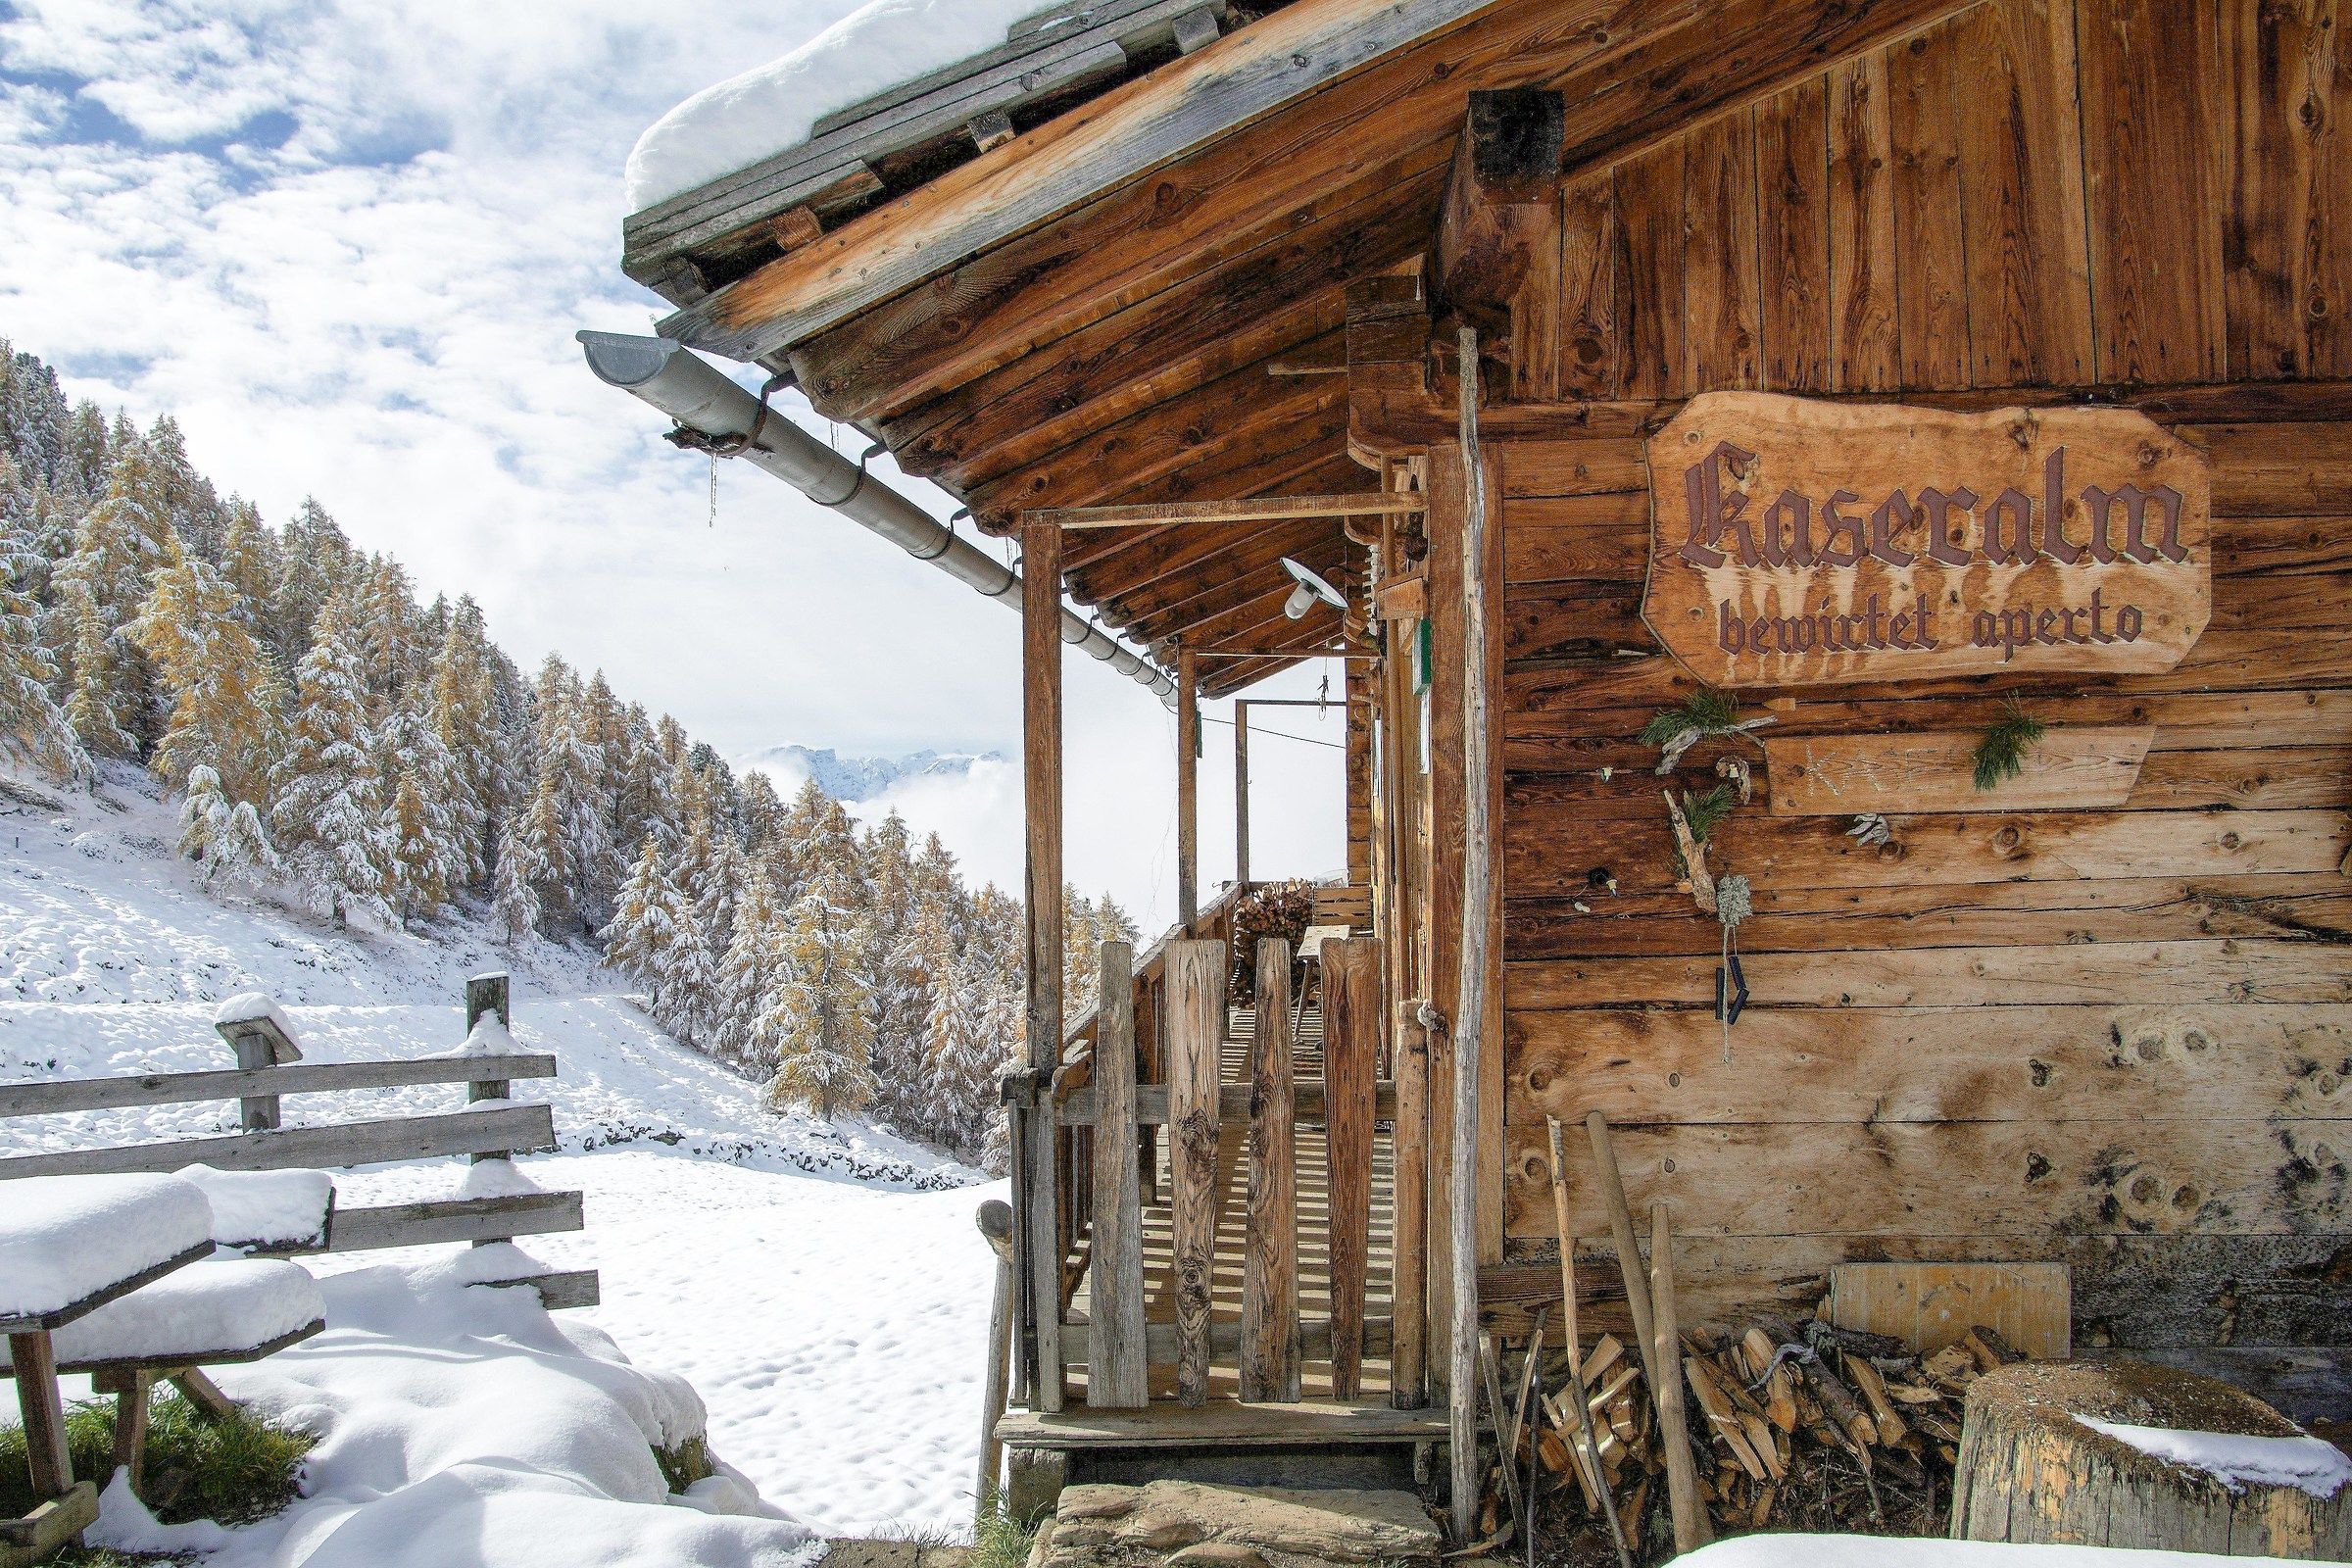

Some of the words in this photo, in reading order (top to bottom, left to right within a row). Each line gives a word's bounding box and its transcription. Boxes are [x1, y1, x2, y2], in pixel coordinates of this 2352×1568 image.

[1678, 439, 2189, 568] Kaseralm
[1718, 593, 1940, 657] bewirtet
[1972, 587, 2143, 663] aperto
